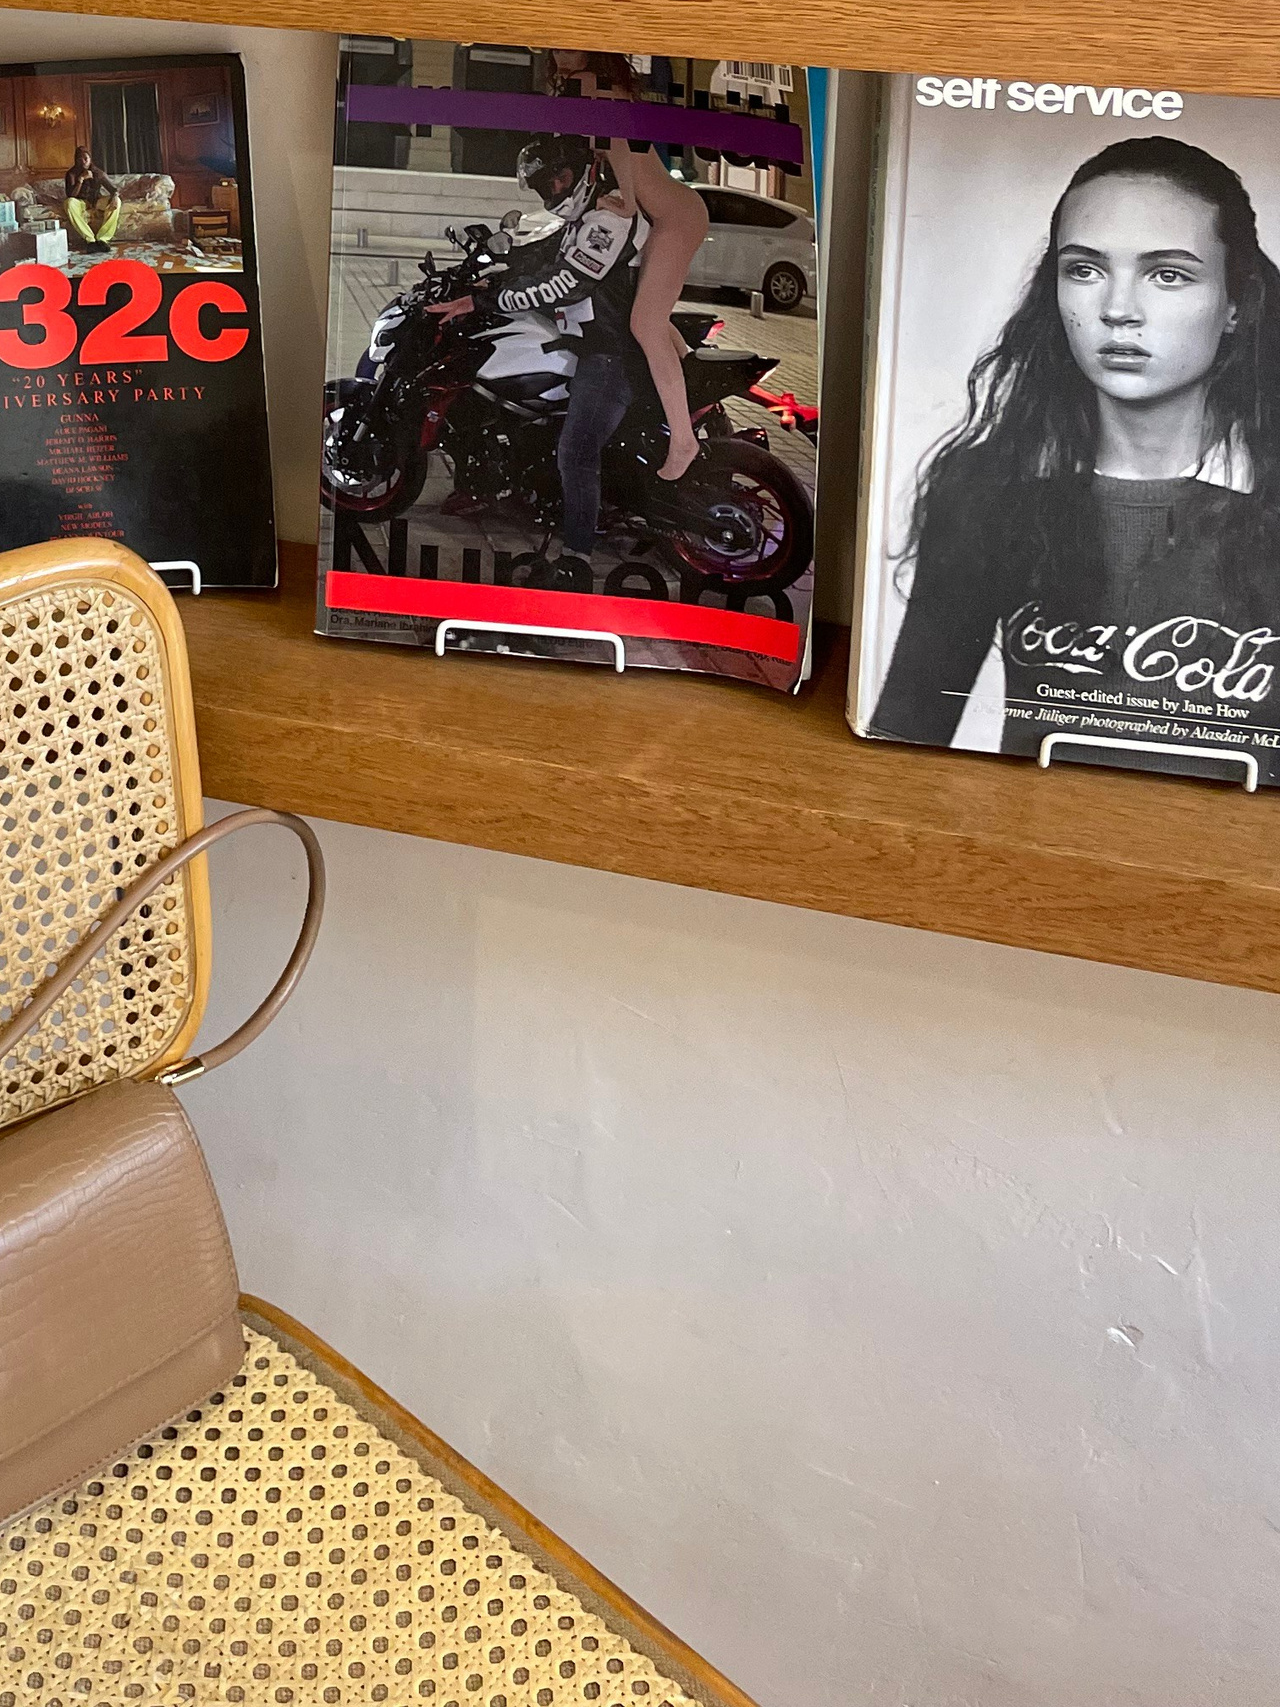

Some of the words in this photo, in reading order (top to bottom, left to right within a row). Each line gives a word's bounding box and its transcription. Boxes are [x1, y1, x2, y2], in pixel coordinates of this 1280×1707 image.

[915, 76, 1001, 110] self
[1007, 80, 1184, 120] service
[498, 269, 579, 313] Corona
[12, 374, 46, 390] “20
[57, 368, 143, 388] YEARS”
[134, 385, 206, 403] PARTY
[60, 413, 100, 424] GUNNA
[1037, 683, 1123, 705] Guest-edited
[1126, 692, 1160, 709] issue
[1162, 695, 1179, 713] by
[1182, 699, 1213, 716] Jane
[1216, 702, 1250, 719] How
[1035, 708, 1080, 727] Jüliger
[1080, 711, 1170, 736] photographed
[1172, 724, 1190, 740] by
[1190, 725, 1250, 745] Alasdair
